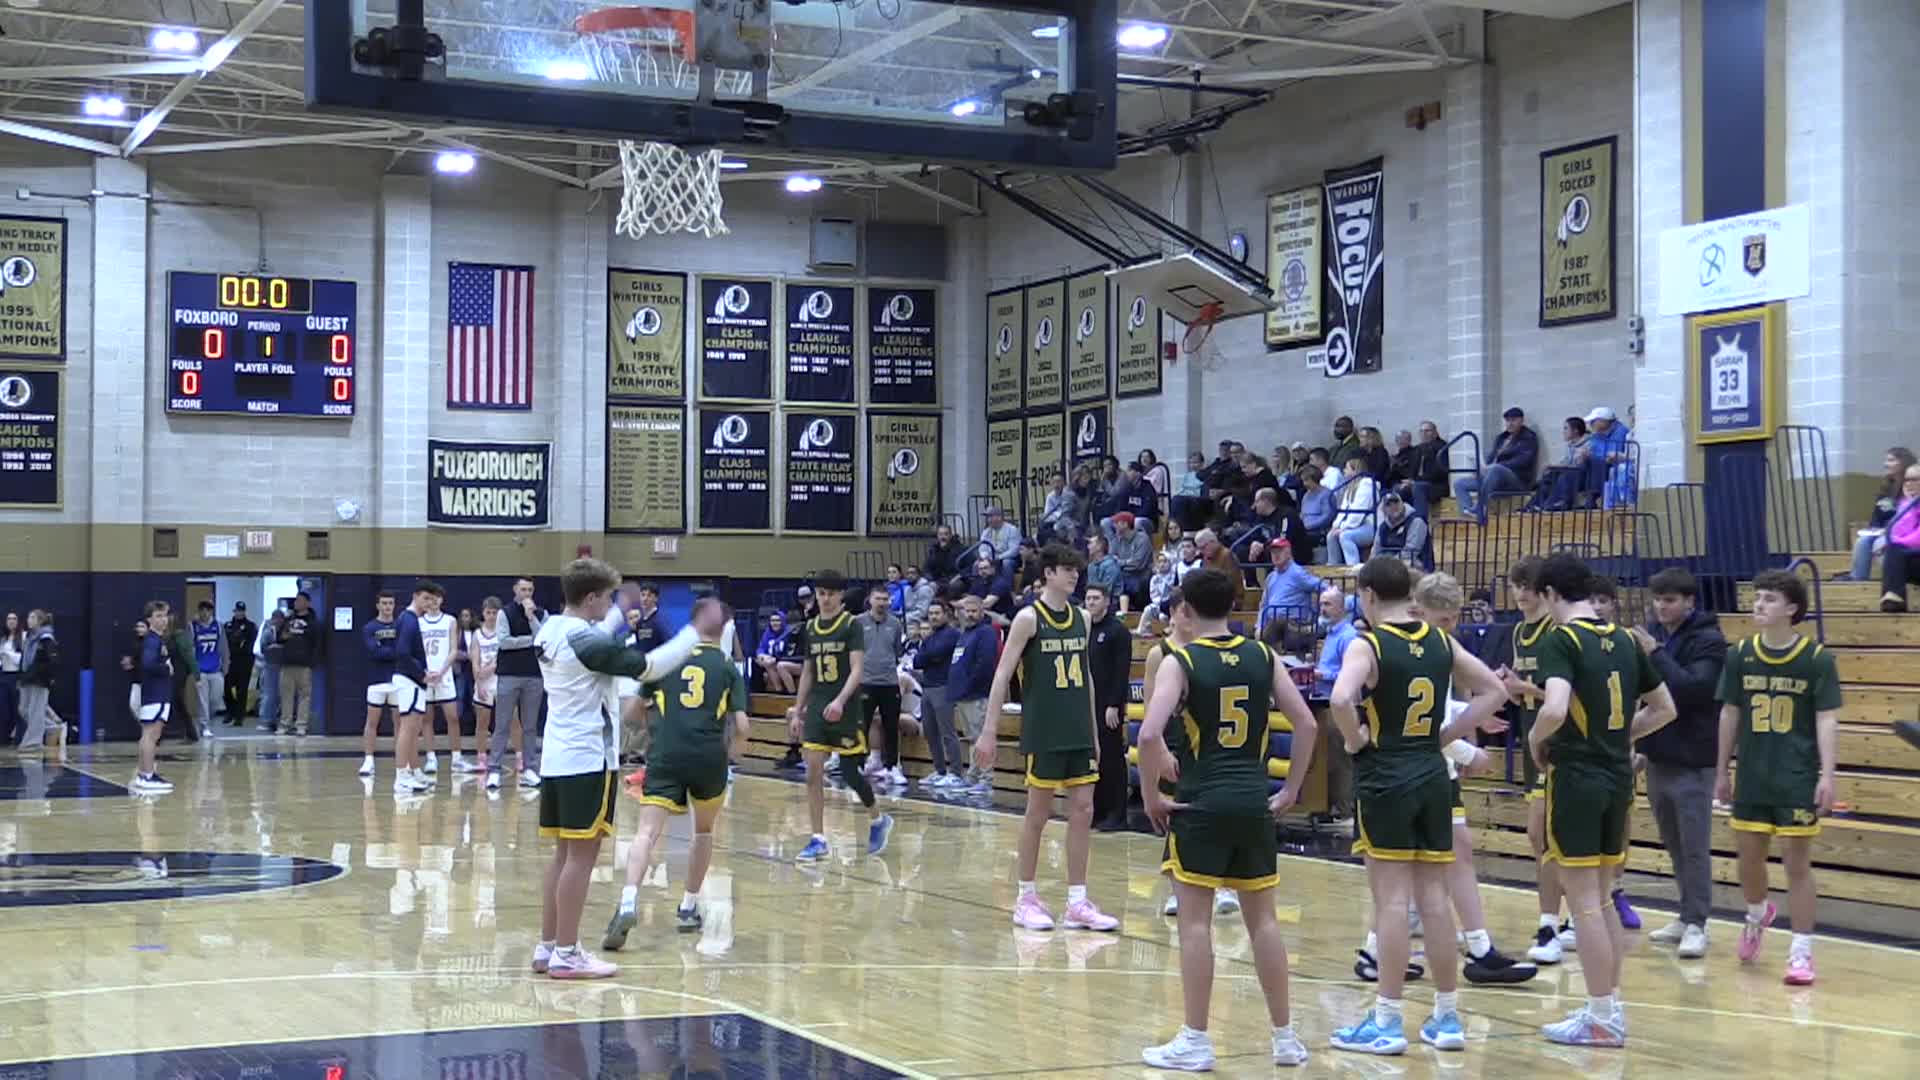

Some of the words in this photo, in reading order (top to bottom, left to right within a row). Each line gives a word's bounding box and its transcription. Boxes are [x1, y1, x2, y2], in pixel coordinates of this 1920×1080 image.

[1563, 157, 1593, 175] GIRLS
[1560, 174, 1596, 193] SOCCER
[22, 229, 56, 241] TRACK
[18, 242, 59, 255] MEDLEY
[1334, 197, 1374, 307] FOCUS
[1563, 254, 1590, 270] 1987
[632, 281, 663, 292] GIRLS
[1559, 272, 1592, 290] STATE
[221, 277, 287, 308] 00.0
[651, 295, 681, 305] TRACK
[1545, 289, 1608, 310] CHAMPIONS
[174, 309, 239, 327] FOXBORO
[247, 321, 281, 332] PERIOD
[306, 315, 349, 331] GUEST
[721, 327, 753, 339] CLASS
[800, 332, 841, 344] LEAGUE
[883, 335, 923, 346] LEAGUE
[204, 329, 223, 359] 0
[331, 334, 349, 364] 0
[705, 339, 769, 350] CHAMPIONS
[789, 343, 852, 355] CHAMPIONS
[872, 346, 934, 357] CHAMPIONS
[172, 359, 203, 371] FOULS
[234, 362, 269, 374] PLAYER
[271, 364, 296, 375] FOUL
[323, 366, 353, 377] FOULS
[182, 371, 198, 395] 0
[333, 378, 349, 401] 0
[612, 377, 680, 390] CHAMPIONS
[1719, 369, 1740, 392] 33
[171, 398, 202, 410] SCORE
[247, 401, 279, 413] MATCH
[322, 404, 353, 415] SCORE
[650, 411, 680, 421] TRACK
[890, 423, 919, 433] GIRLS
[433, 448, 544, 481] FOXBOROUGH
[719, 458, 752, 469] CLASS
[703, 469, 768, 480] CHAMPIONS
[788, 472, 853, 483] CHAMPIONS
[440, 485, 537, 518] WARRIORS
[873, 515, 936, 527] CHAMPIONS
[815, 655, 839, 682] 13
[1054, 653, 1084, 689] 14
[679, 664, 706, 709] 3
[1402, 676, 1436, 737] 2
[1606, 670, 1625, 731] 1
[1217, 685, 1250, 749] 5
[1751, 693, 1793, 734] 20
